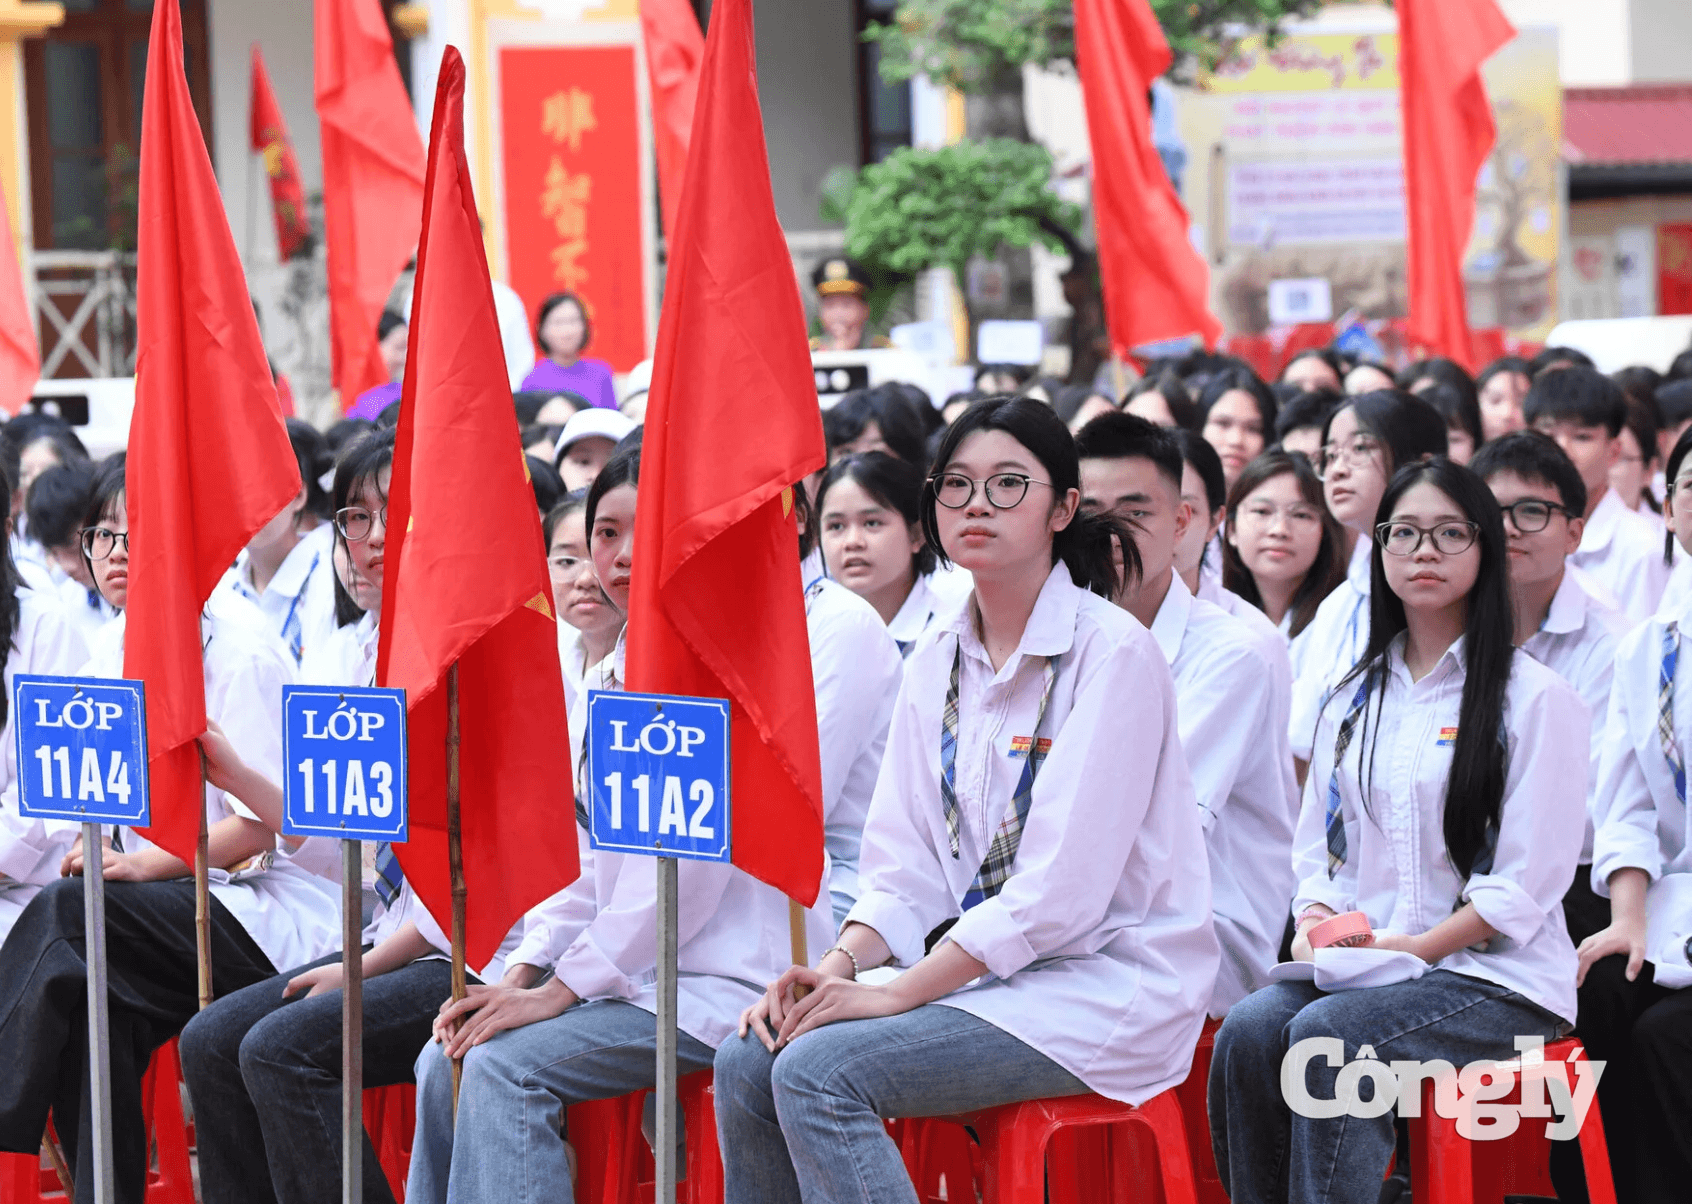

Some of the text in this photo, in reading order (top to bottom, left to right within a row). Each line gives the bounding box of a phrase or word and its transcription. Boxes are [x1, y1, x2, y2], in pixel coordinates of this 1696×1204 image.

[34, 691, 123, 731] LỚP
[302, 701, 385, 741] LỚP
[609, 713, 706, 757] LỚP
[34, 744, 132, 805] 11A4
[298, 758, 393, 818] 11A3
[604, 771, 715, 839] 11A2
